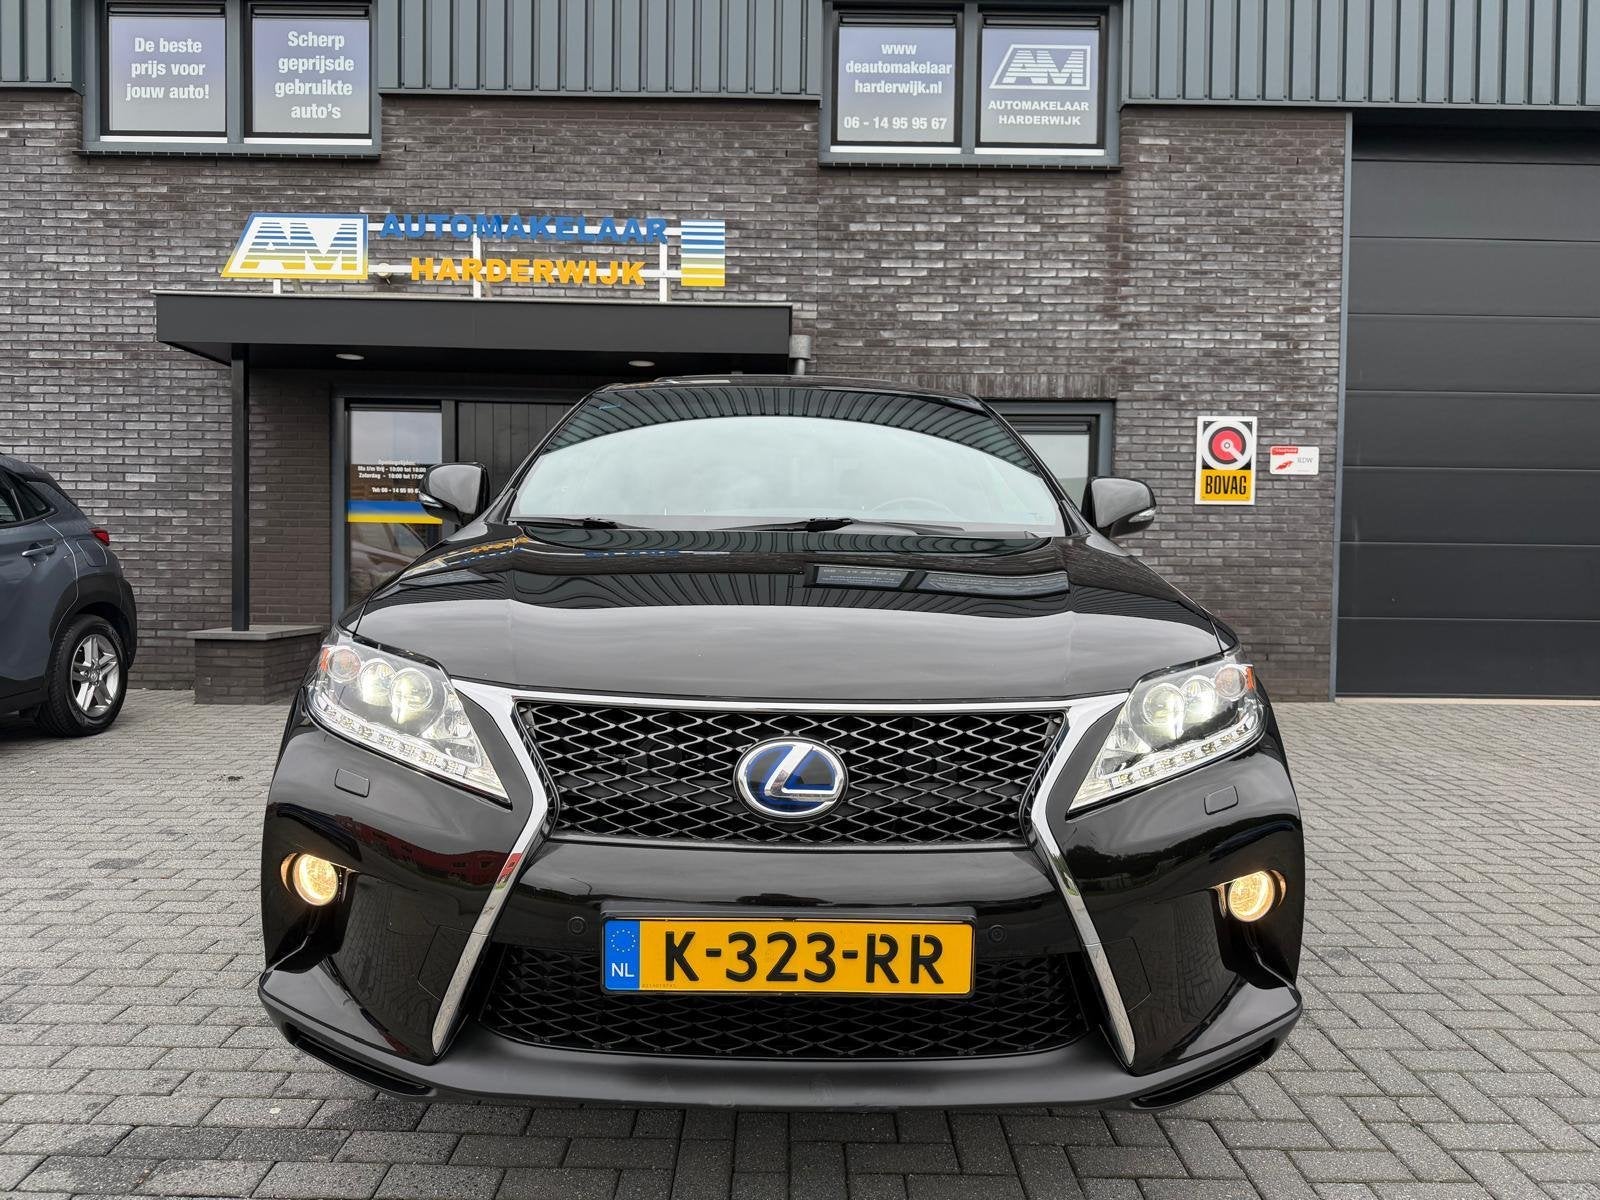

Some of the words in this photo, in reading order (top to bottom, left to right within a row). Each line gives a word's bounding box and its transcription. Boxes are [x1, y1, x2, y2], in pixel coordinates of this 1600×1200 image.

[134, 38, 155, 52] De
[160, 38, 202, 53] beste
[288, 31, 345, 50] Scherp
[881, 44, 917, 55] www
[131, 61, 166, 78] prijs
[171, 63, 205, 76] voor
[278, 55, 354, 74] geprijsde
[846, 61, 953, 75] deautomakelaar
[1002, 50, 1084, 85] AM
[125, 84, 165, 101] jouw
[169, 84, 210, 99] auto!
[274, 79, 352, 98] gebruikte
[855, 80, 942, 97] harderwijk.nl
[290, 103, 341, 119] auto's
[988, 100, 1090, 111] AUTOMAKELAAR
[844, 117, 860, 129] 06
[873, 117, 889, 129] 14
[892, 117, 909, 129] 95
[912, 117, 928, 129] 95
[931, 118, 948, 130] 67
[999, 114, 1082, 126] HARDERWIJK
[380, 213, 668, 244] AUTOMAKELAAR
[241, 221, 358, 271] AM
[411, 256, 646, 286] HARDERWIJK
[1205, 475, 1247, 495] BOVAG
[665, 931, 945, 985] K-323-RR
[611, 962, 634, 978] NL
